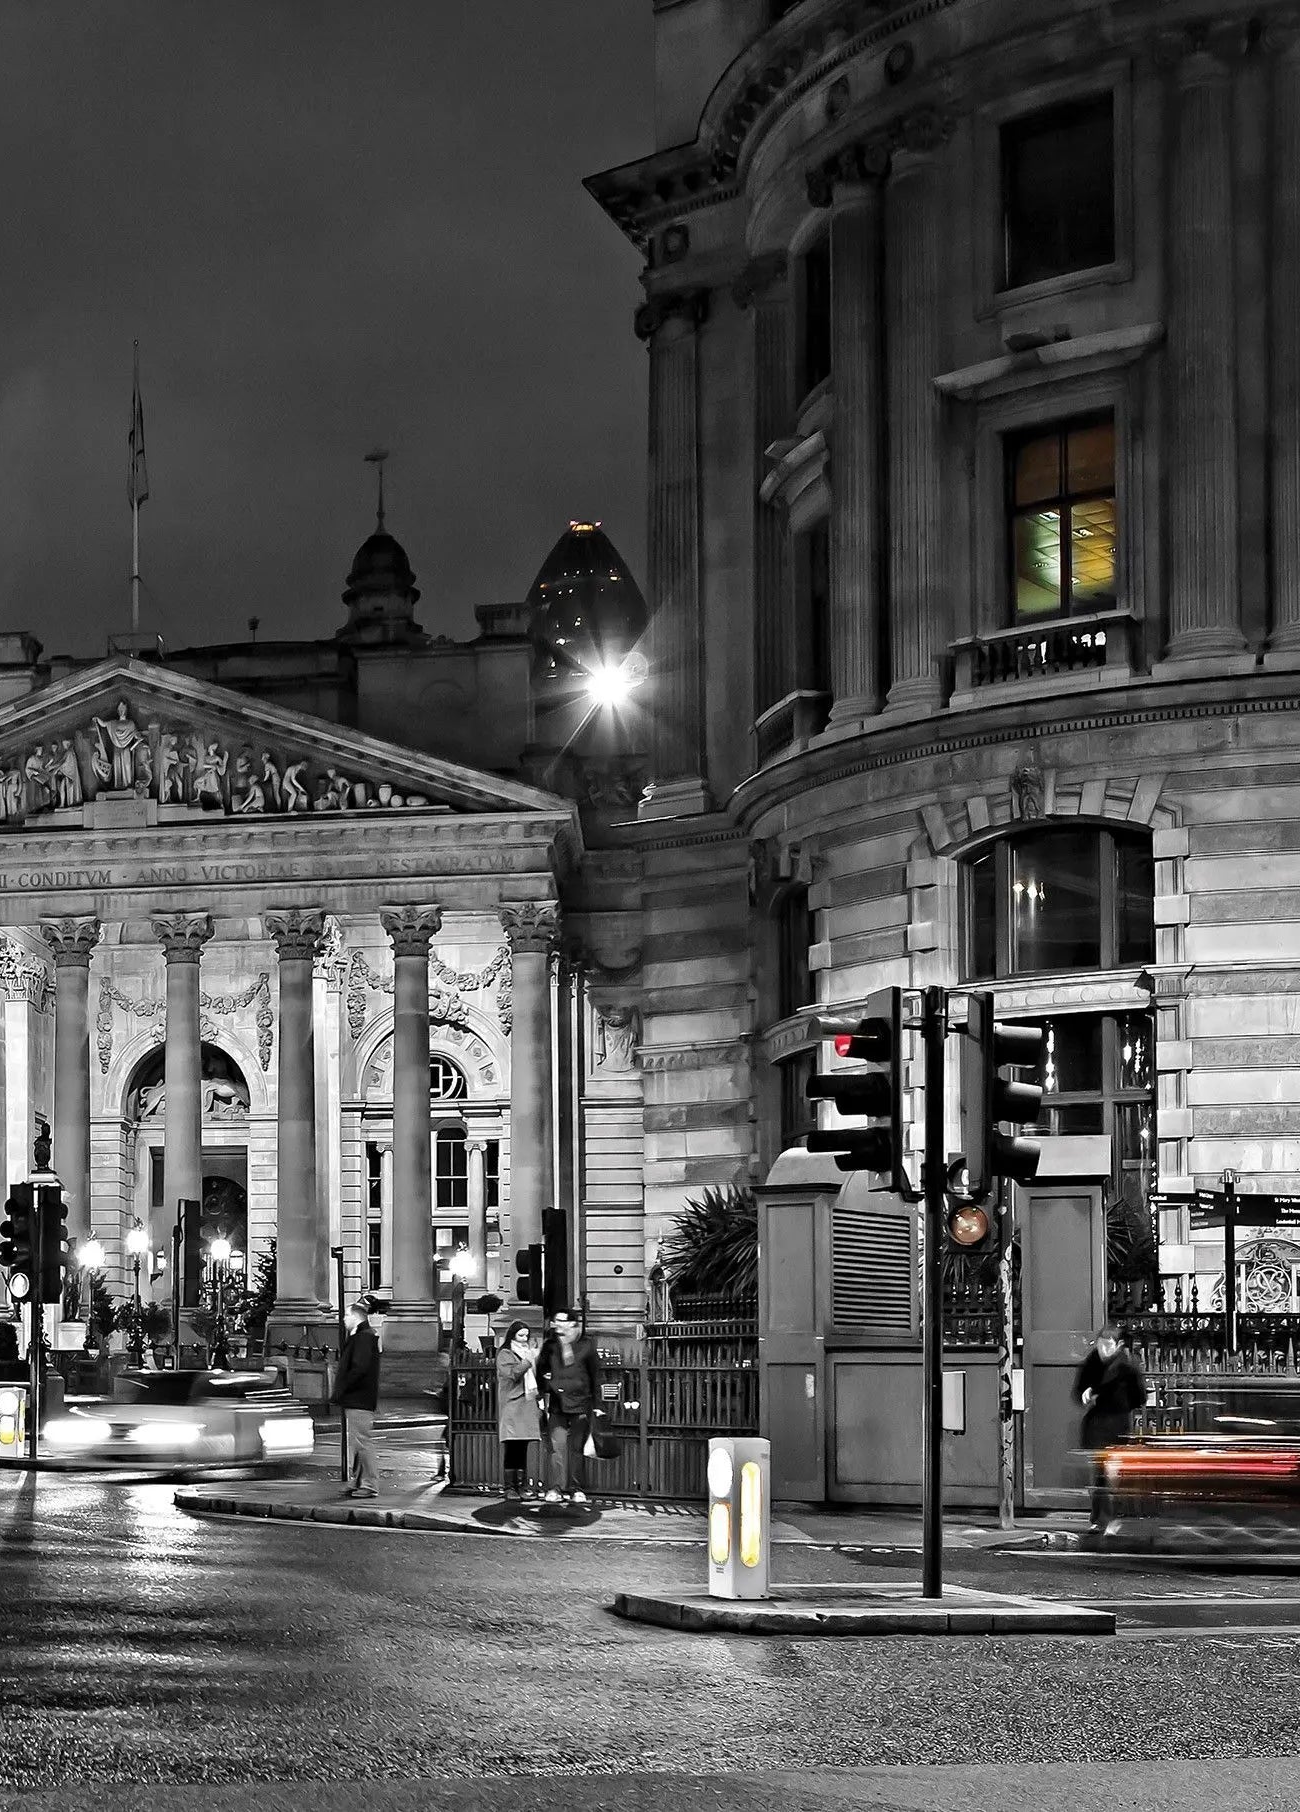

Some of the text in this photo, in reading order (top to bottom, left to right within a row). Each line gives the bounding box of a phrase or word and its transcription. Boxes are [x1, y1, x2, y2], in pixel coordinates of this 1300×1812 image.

[18, 869, 112, 888] CONDITVM
[135, 866, 188, 884] ANNO
[201, 862, 301, 882] VICTORIAE
